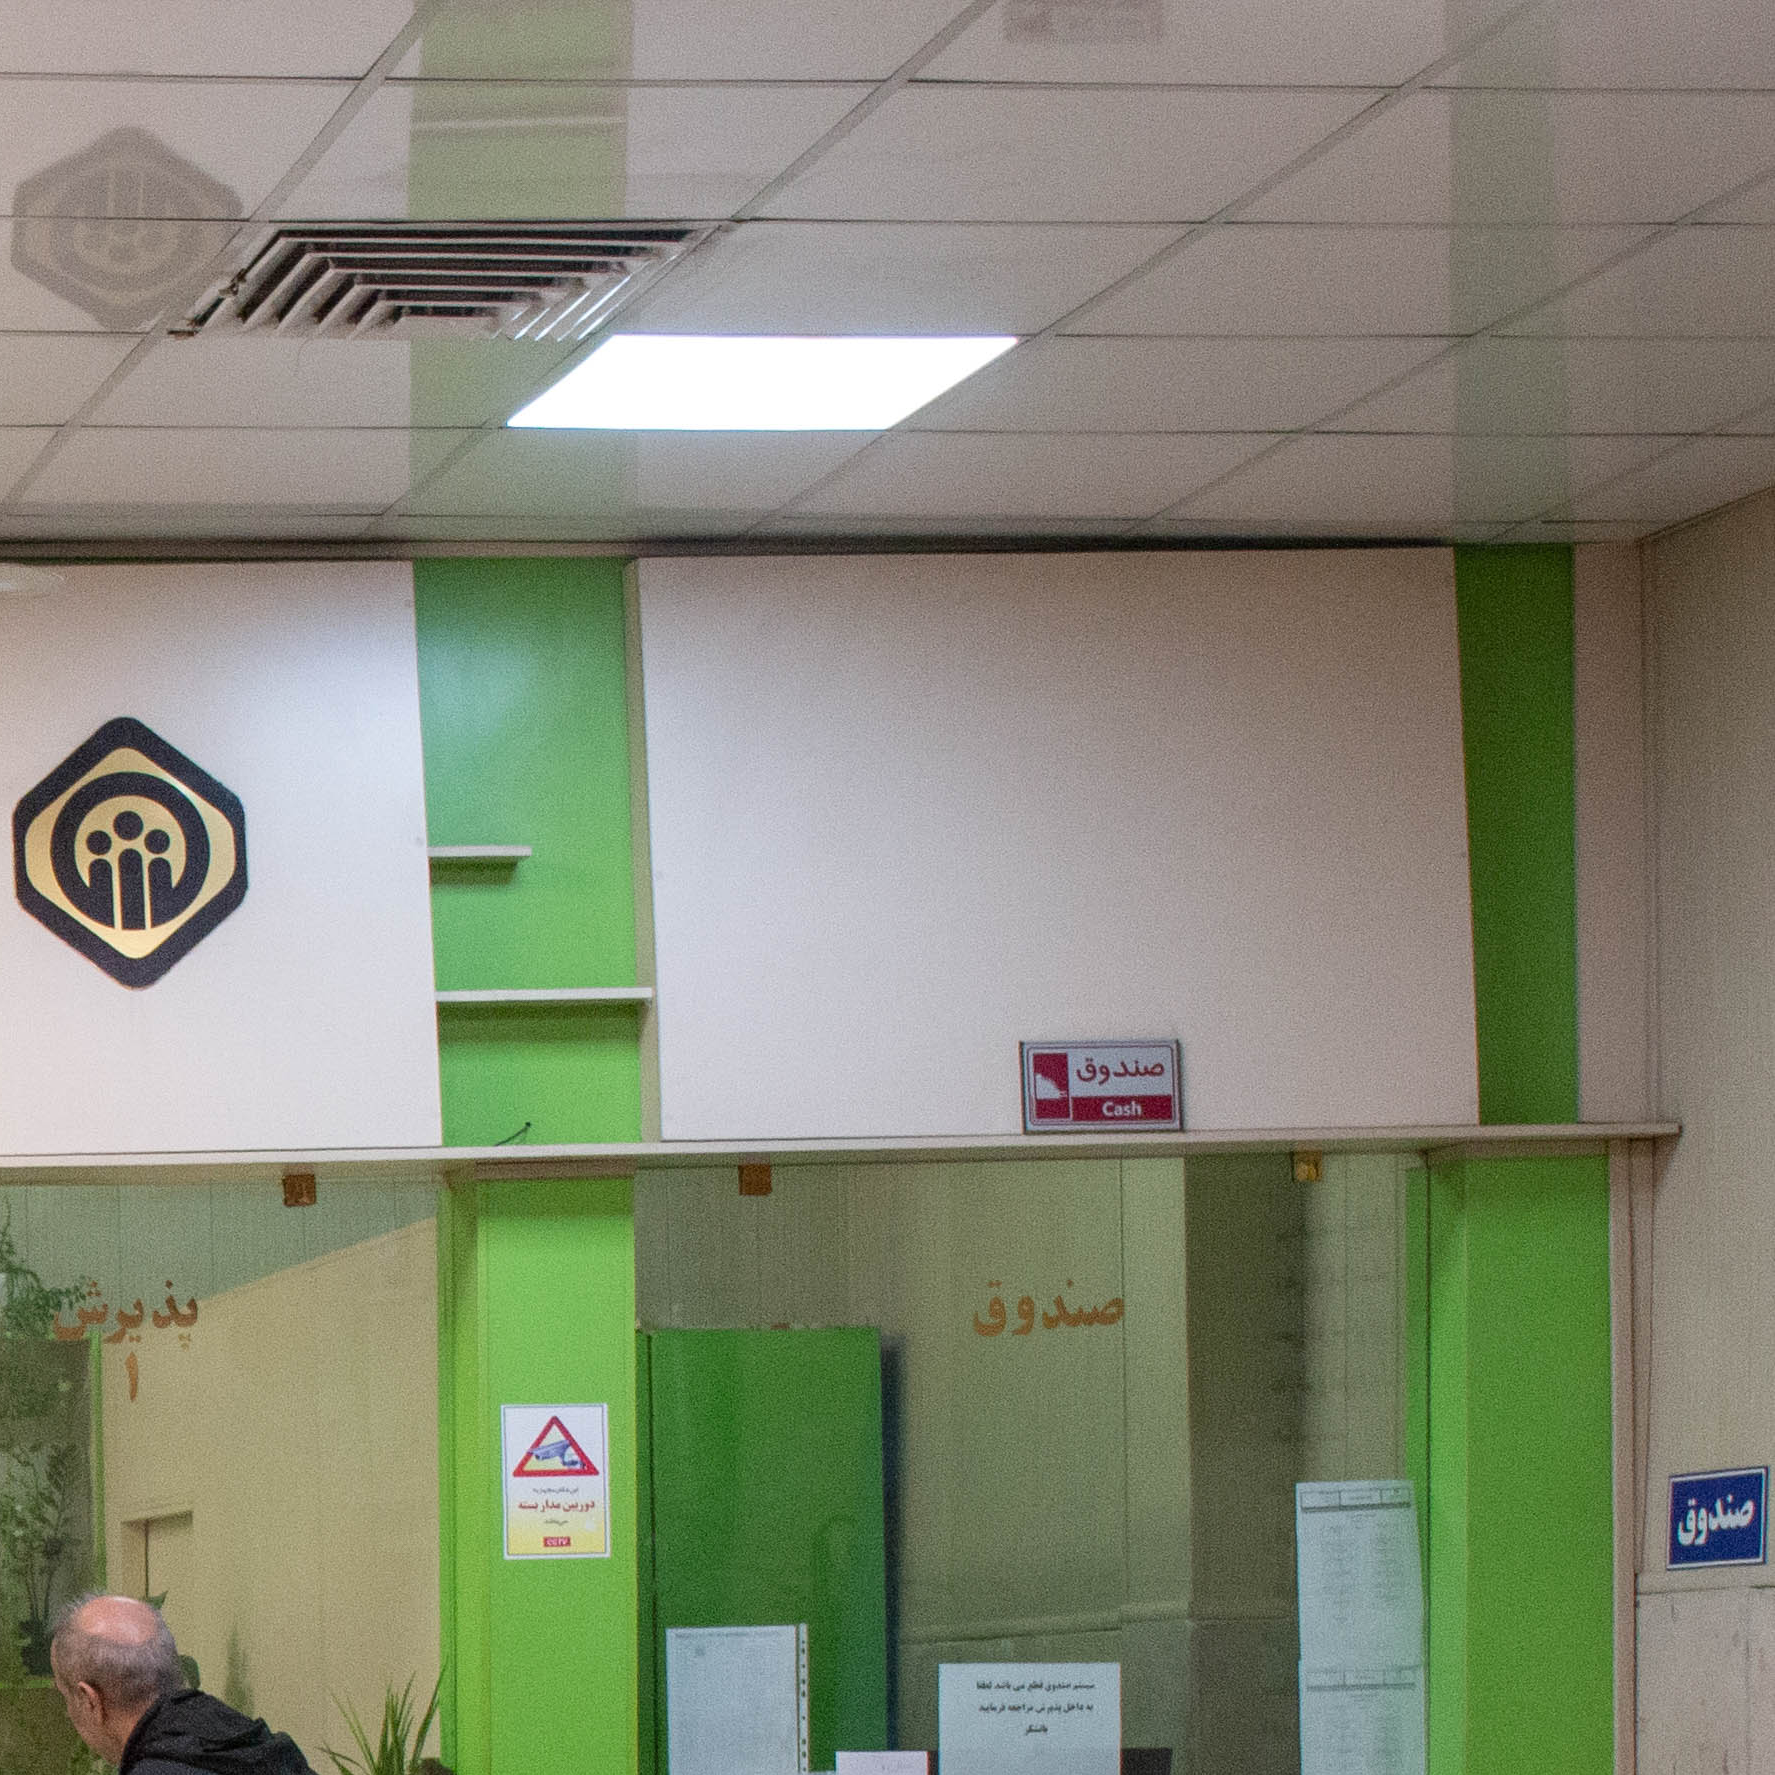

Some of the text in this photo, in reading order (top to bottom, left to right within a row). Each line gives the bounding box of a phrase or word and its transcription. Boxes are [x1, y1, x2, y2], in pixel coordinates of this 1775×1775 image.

[1077, 1058, 1165, 1086] صندوق
[1102, 1101, 1142, 1117] Cash
[53, 1279, 198, 1350] پذیرش
[973, 1279, 1125, 1337] صندوق
[1677, 1493, 1755, 1546] صندوق
